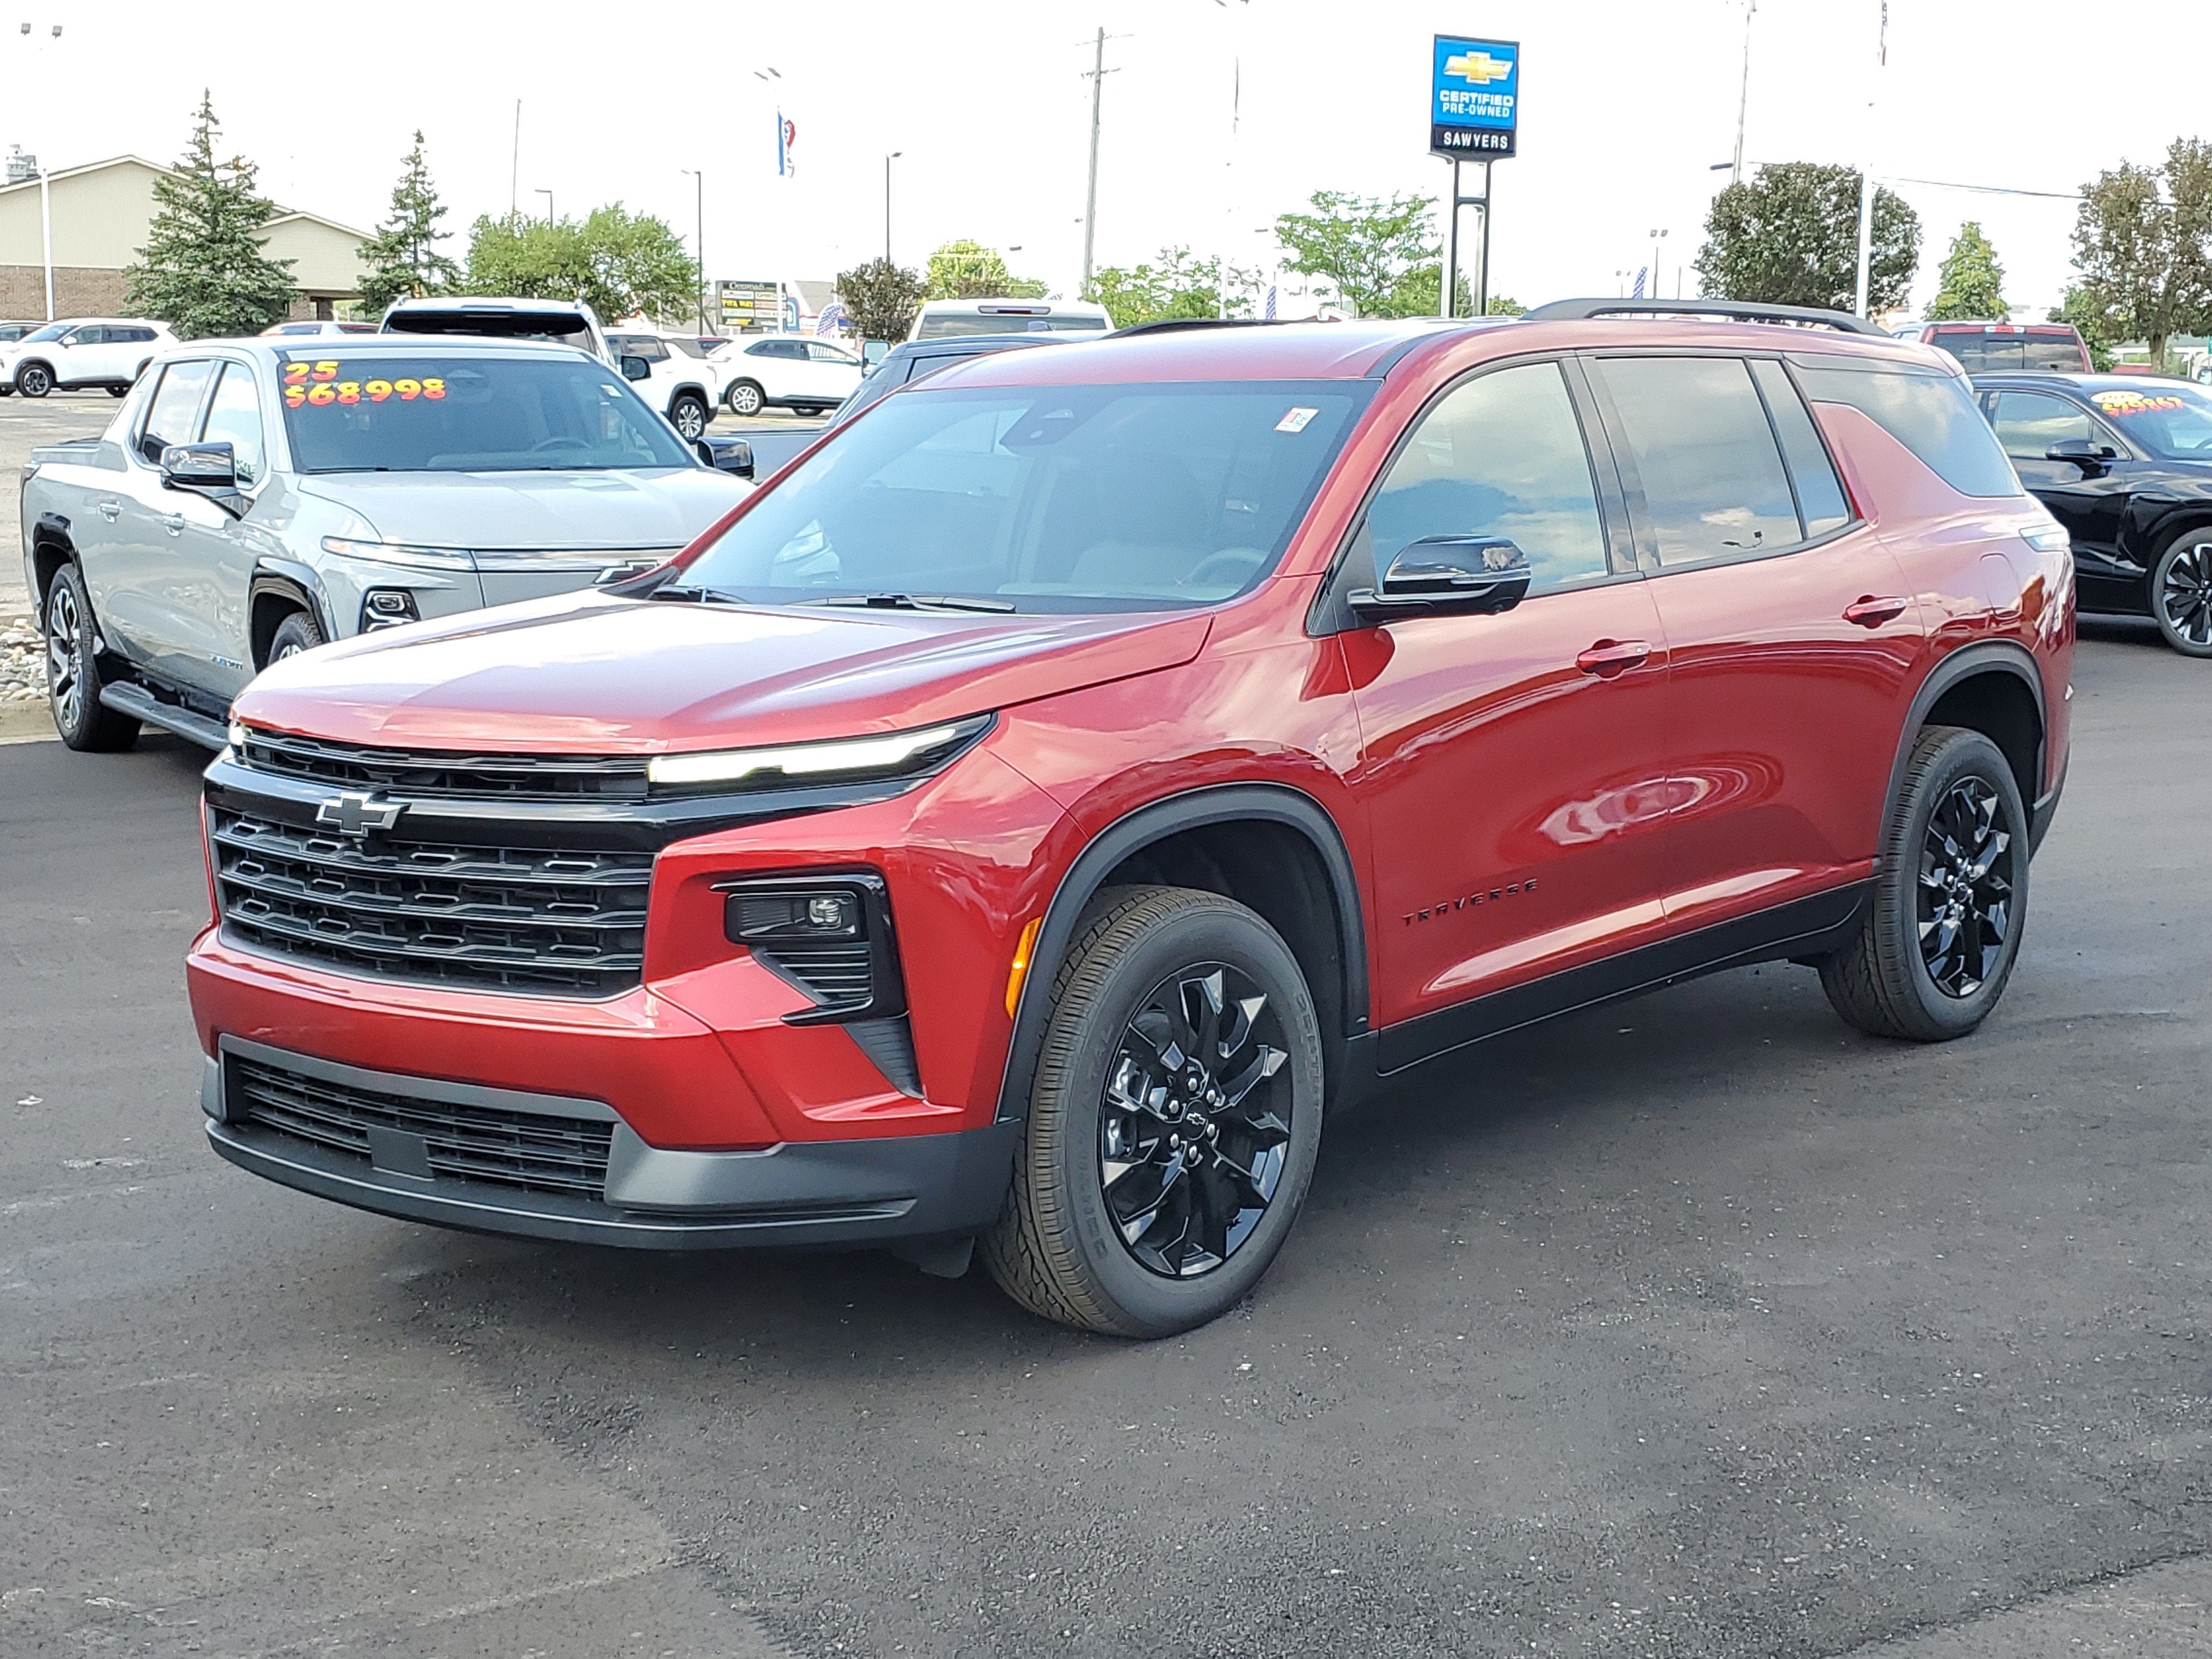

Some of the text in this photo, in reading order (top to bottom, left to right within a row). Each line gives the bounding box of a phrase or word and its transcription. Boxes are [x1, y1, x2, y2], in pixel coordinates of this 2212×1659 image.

[1440, 90, 1514, 107] CERTIFIED
[1443, 103, 1510, 117] PRE-OWNED
[1443, 131, 1509, 149] SAWYERS
[284, 361, 339, 383] 25
[284, 377, 447, 408] $68998
[1402, 878, 1537, 927] TRAVERSE
